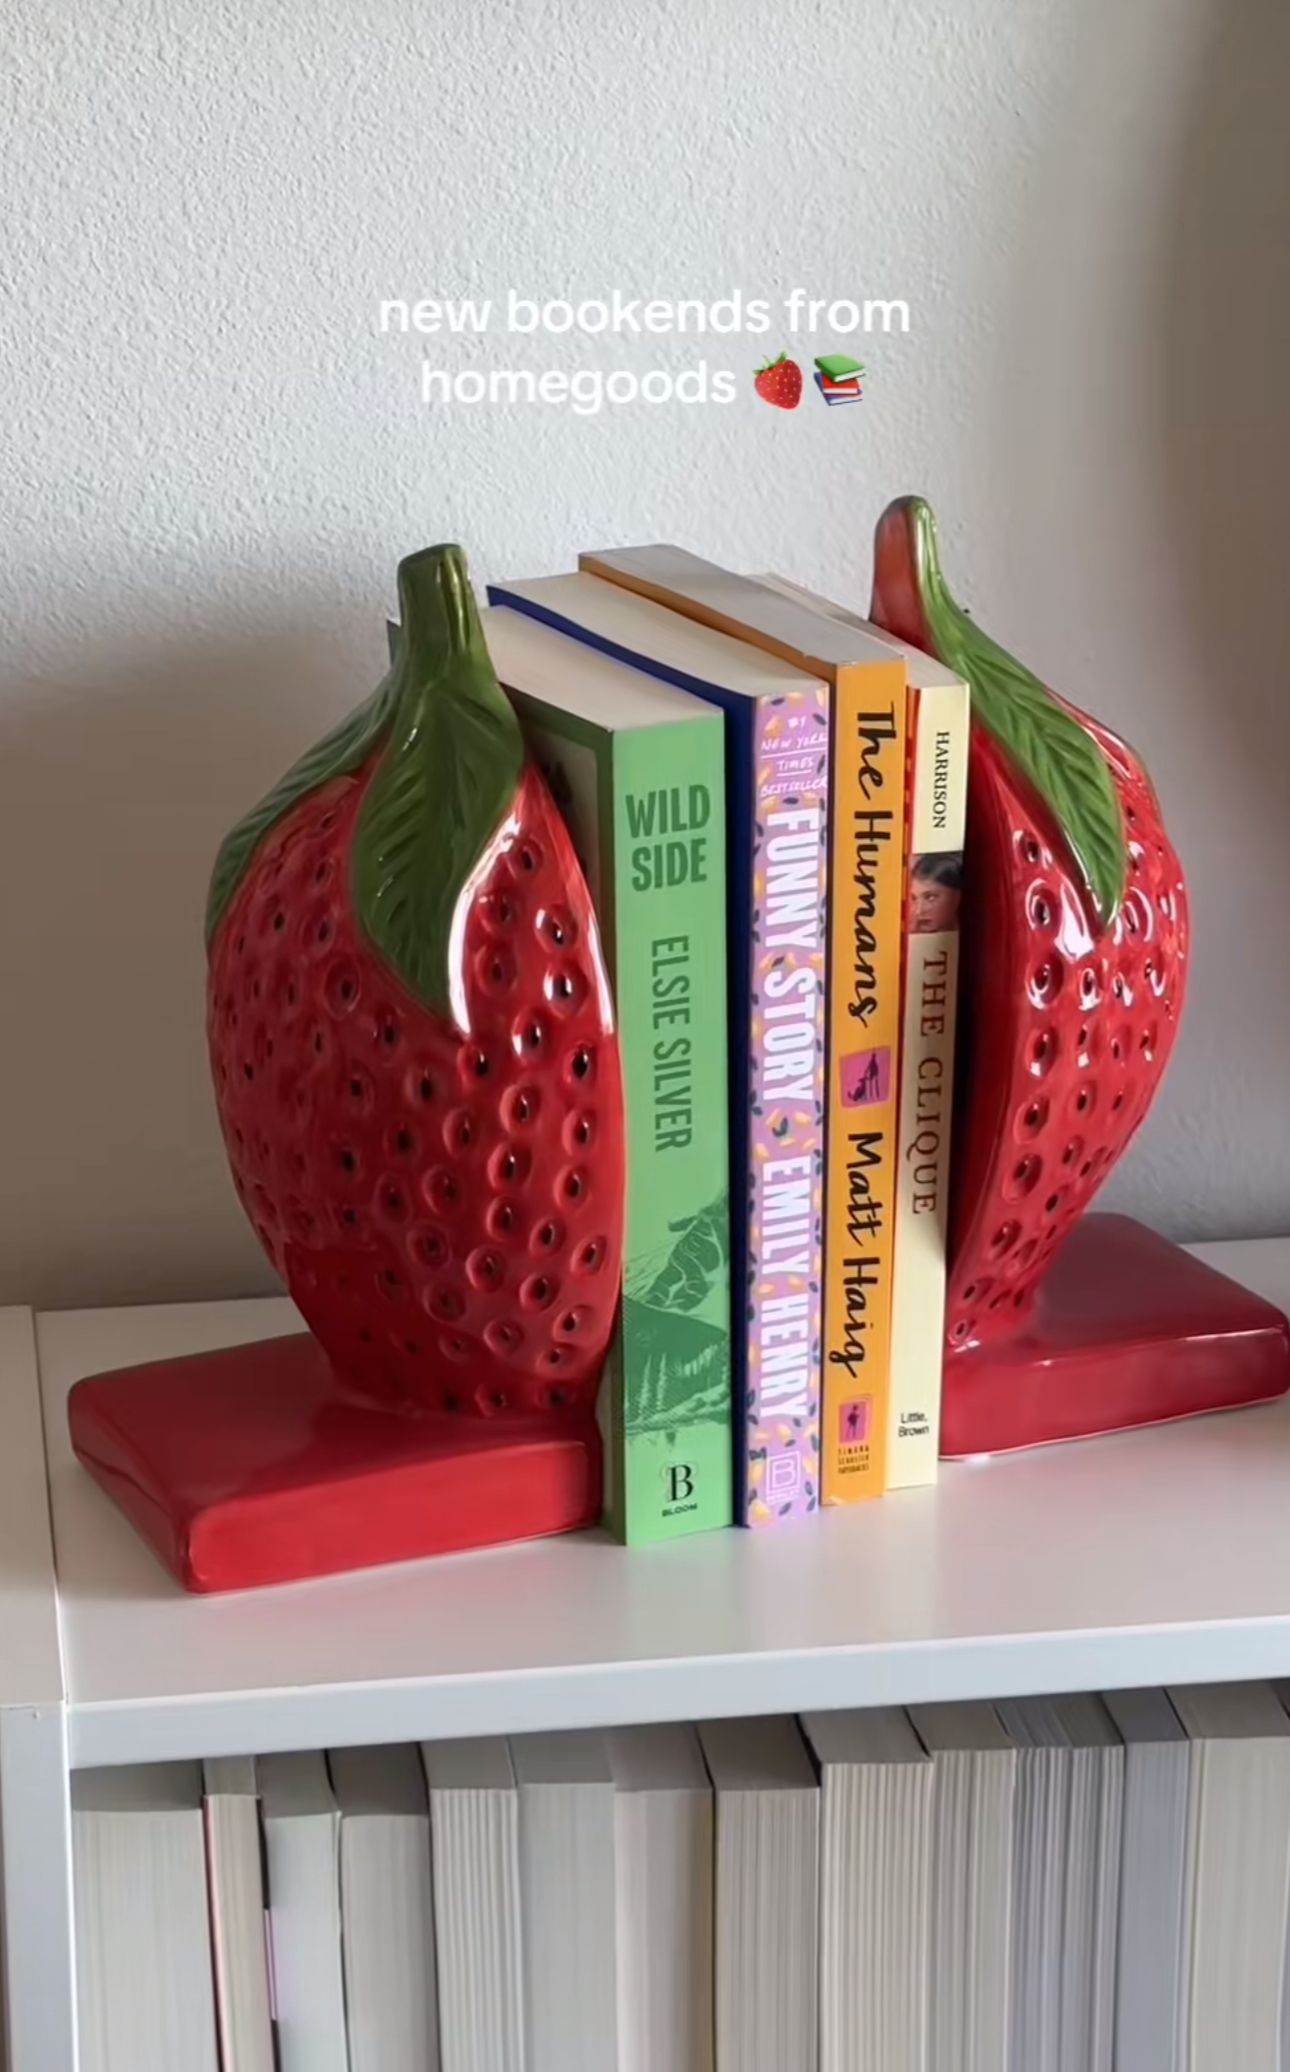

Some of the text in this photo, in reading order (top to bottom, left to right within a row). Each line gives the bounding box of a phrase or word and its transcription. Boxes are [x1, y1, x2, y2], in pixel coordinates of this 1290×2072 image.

[625, 784, 711, 838] WILD
[776, 757, 814, 771] TIMES
[931, 730, 950, 829] HARRISON
[631, 838, 707, 892] SIDE
[848, 701, 898, 1028] The Humans
[763, 806, 820, 1101] FUNNY STORY
[651, 935, 693, 1152] ELSIE SILVER
[906, 950, 947, 1214] THE CLIQUE
[760, 1155, 811, 1417] EMILY HENRY
[829, 1132, 884, 1378] Matt Haig
[661, 1502, 698, 1517] BLOOM
[898, 1426, 930, 1437] Brown
